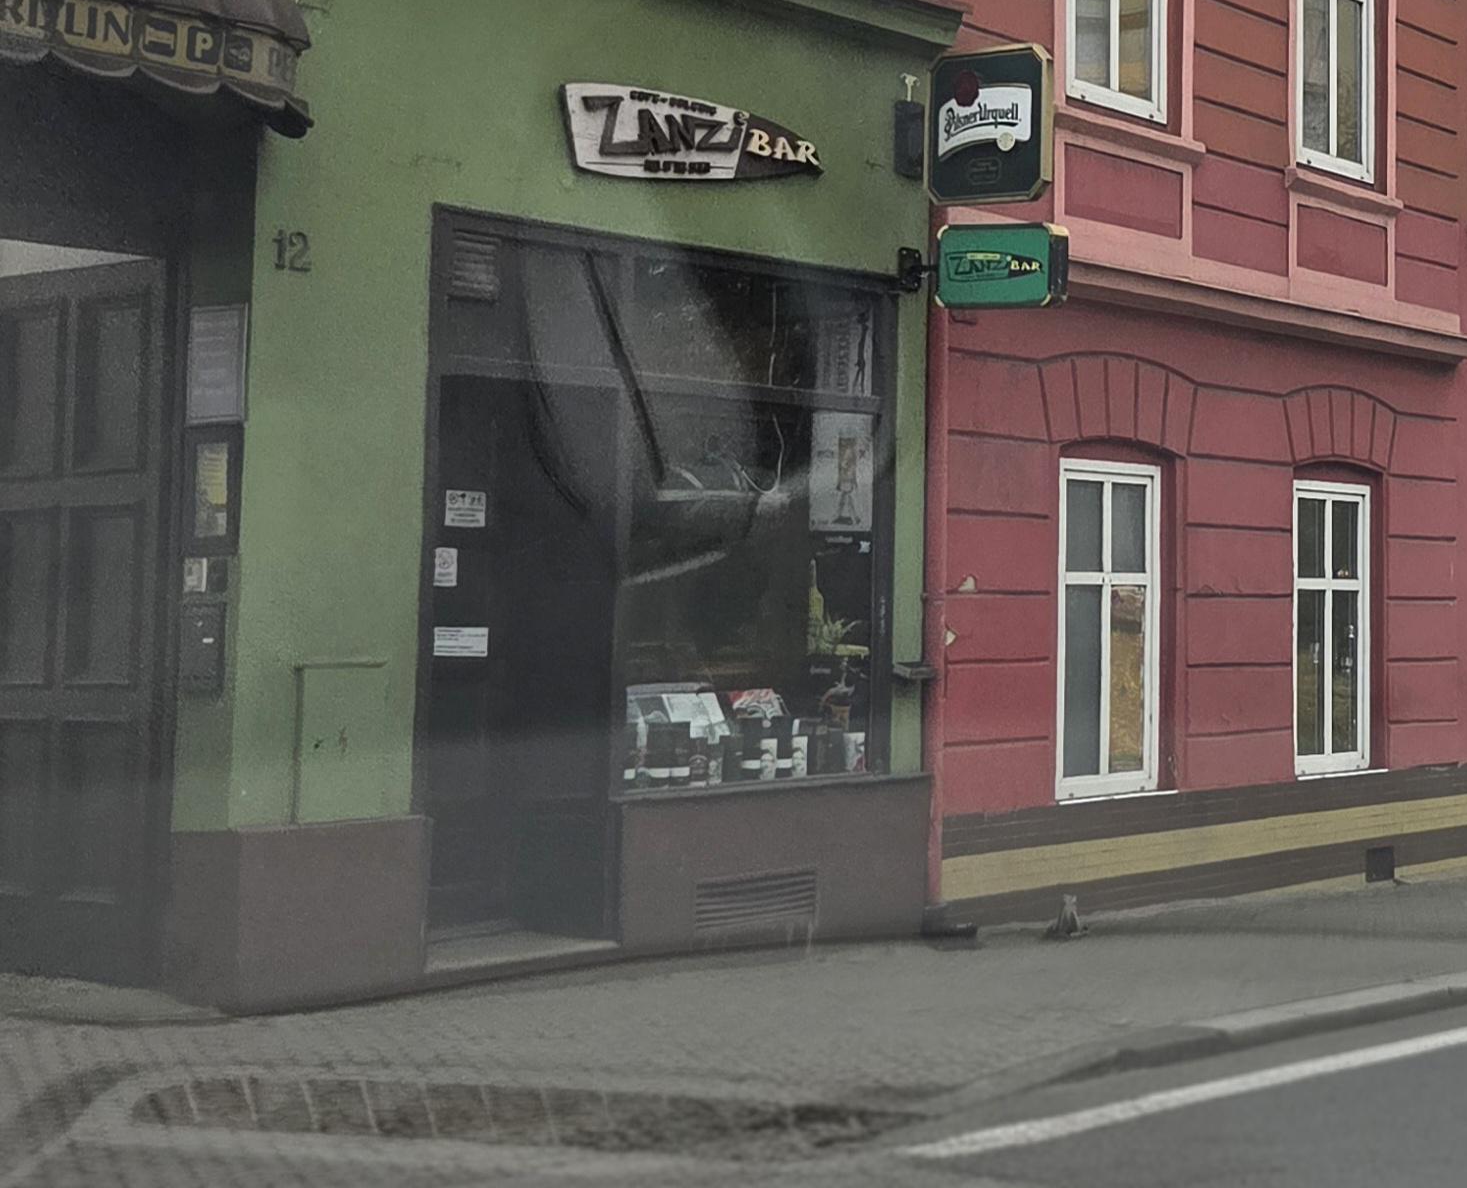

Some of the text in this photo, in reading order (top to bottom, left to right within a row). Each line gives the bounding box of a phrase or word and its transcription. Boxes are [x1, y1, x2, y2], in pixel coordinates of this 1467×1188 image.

[943, 102, 1019, 142] Pilsner Urquell
[747, 129, 820, 167] BAR
[272, 229, 312, 272] 12
[1010, 260, 1040, 272] BAR
